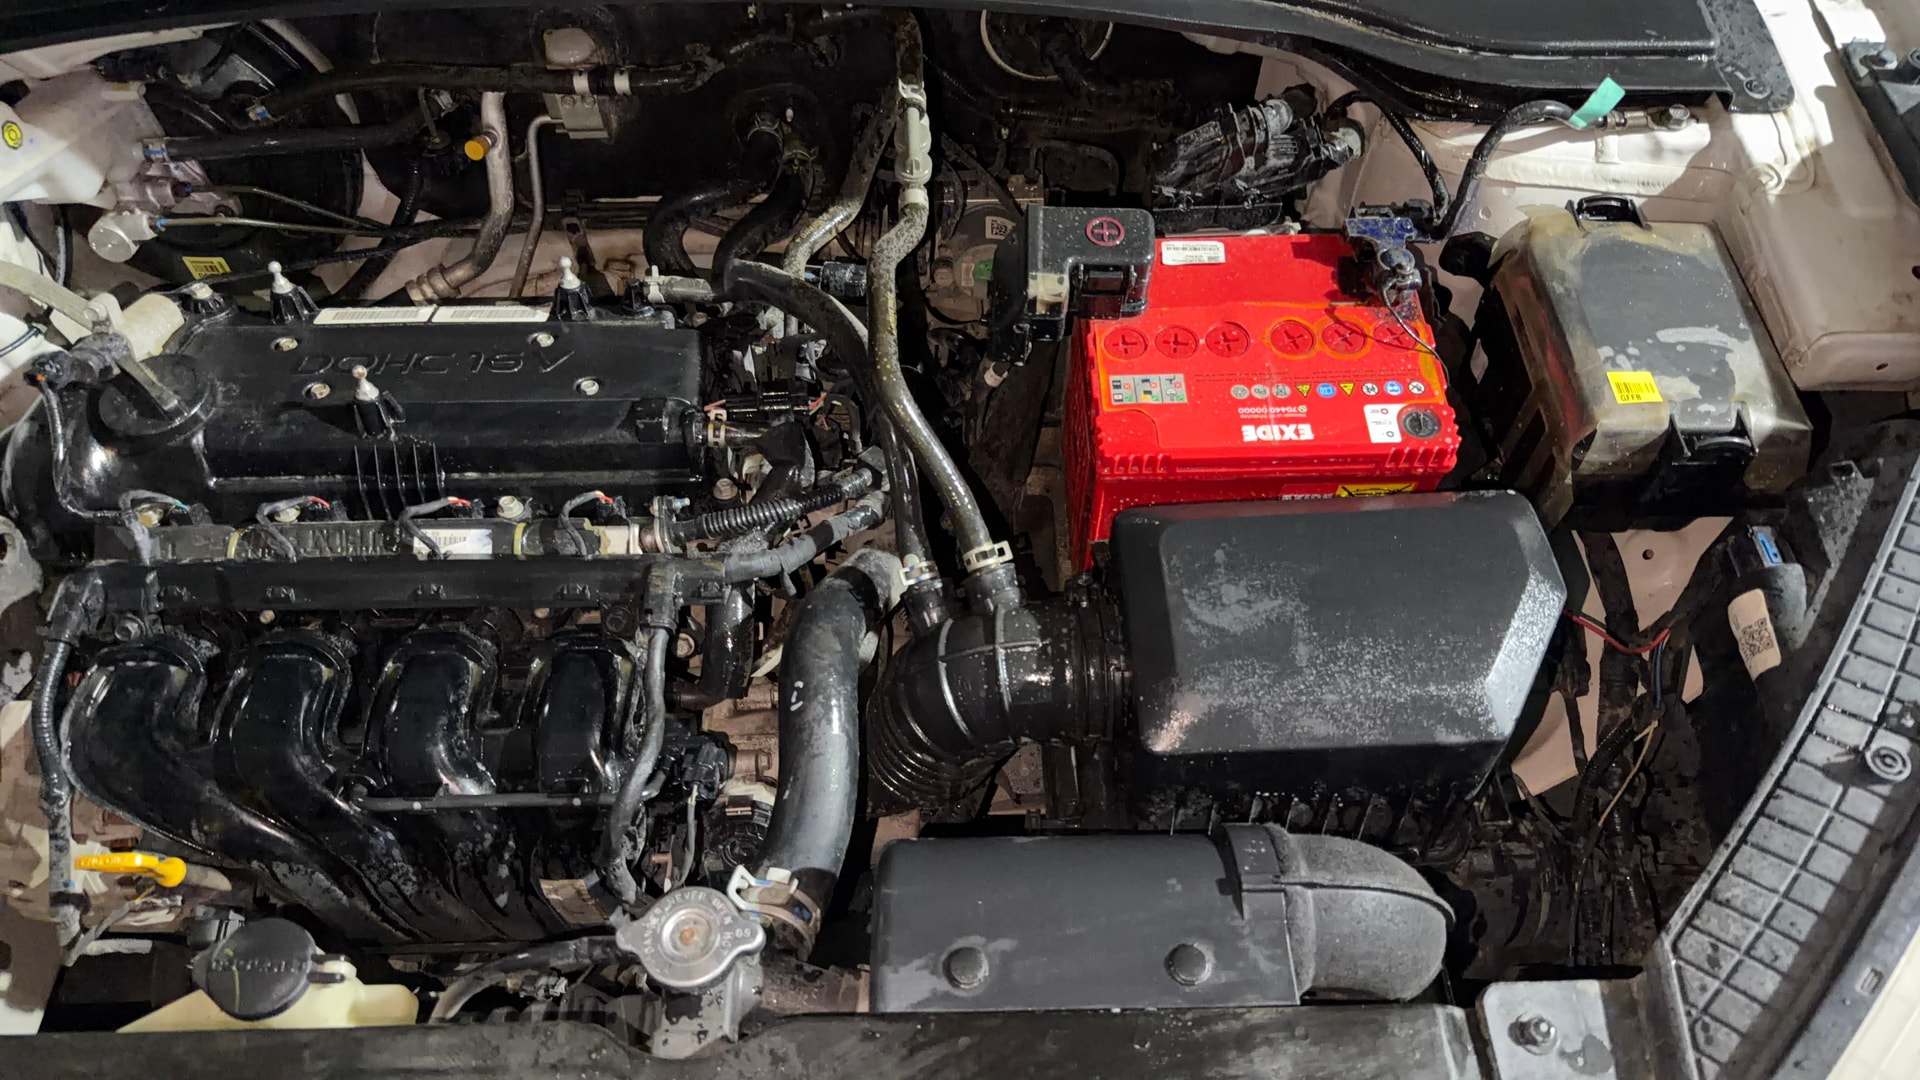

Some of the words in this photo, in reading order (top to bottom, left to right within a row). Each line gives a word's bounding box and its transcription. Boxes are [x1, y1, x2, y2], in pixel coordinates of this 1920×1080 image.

[291, 352, 457, 376] DOHC
[1269, 405, 1298, 413] 70440
[1241, 423, 1315, 442] EXIDE
[666, 890, 708, 909] NEVER
